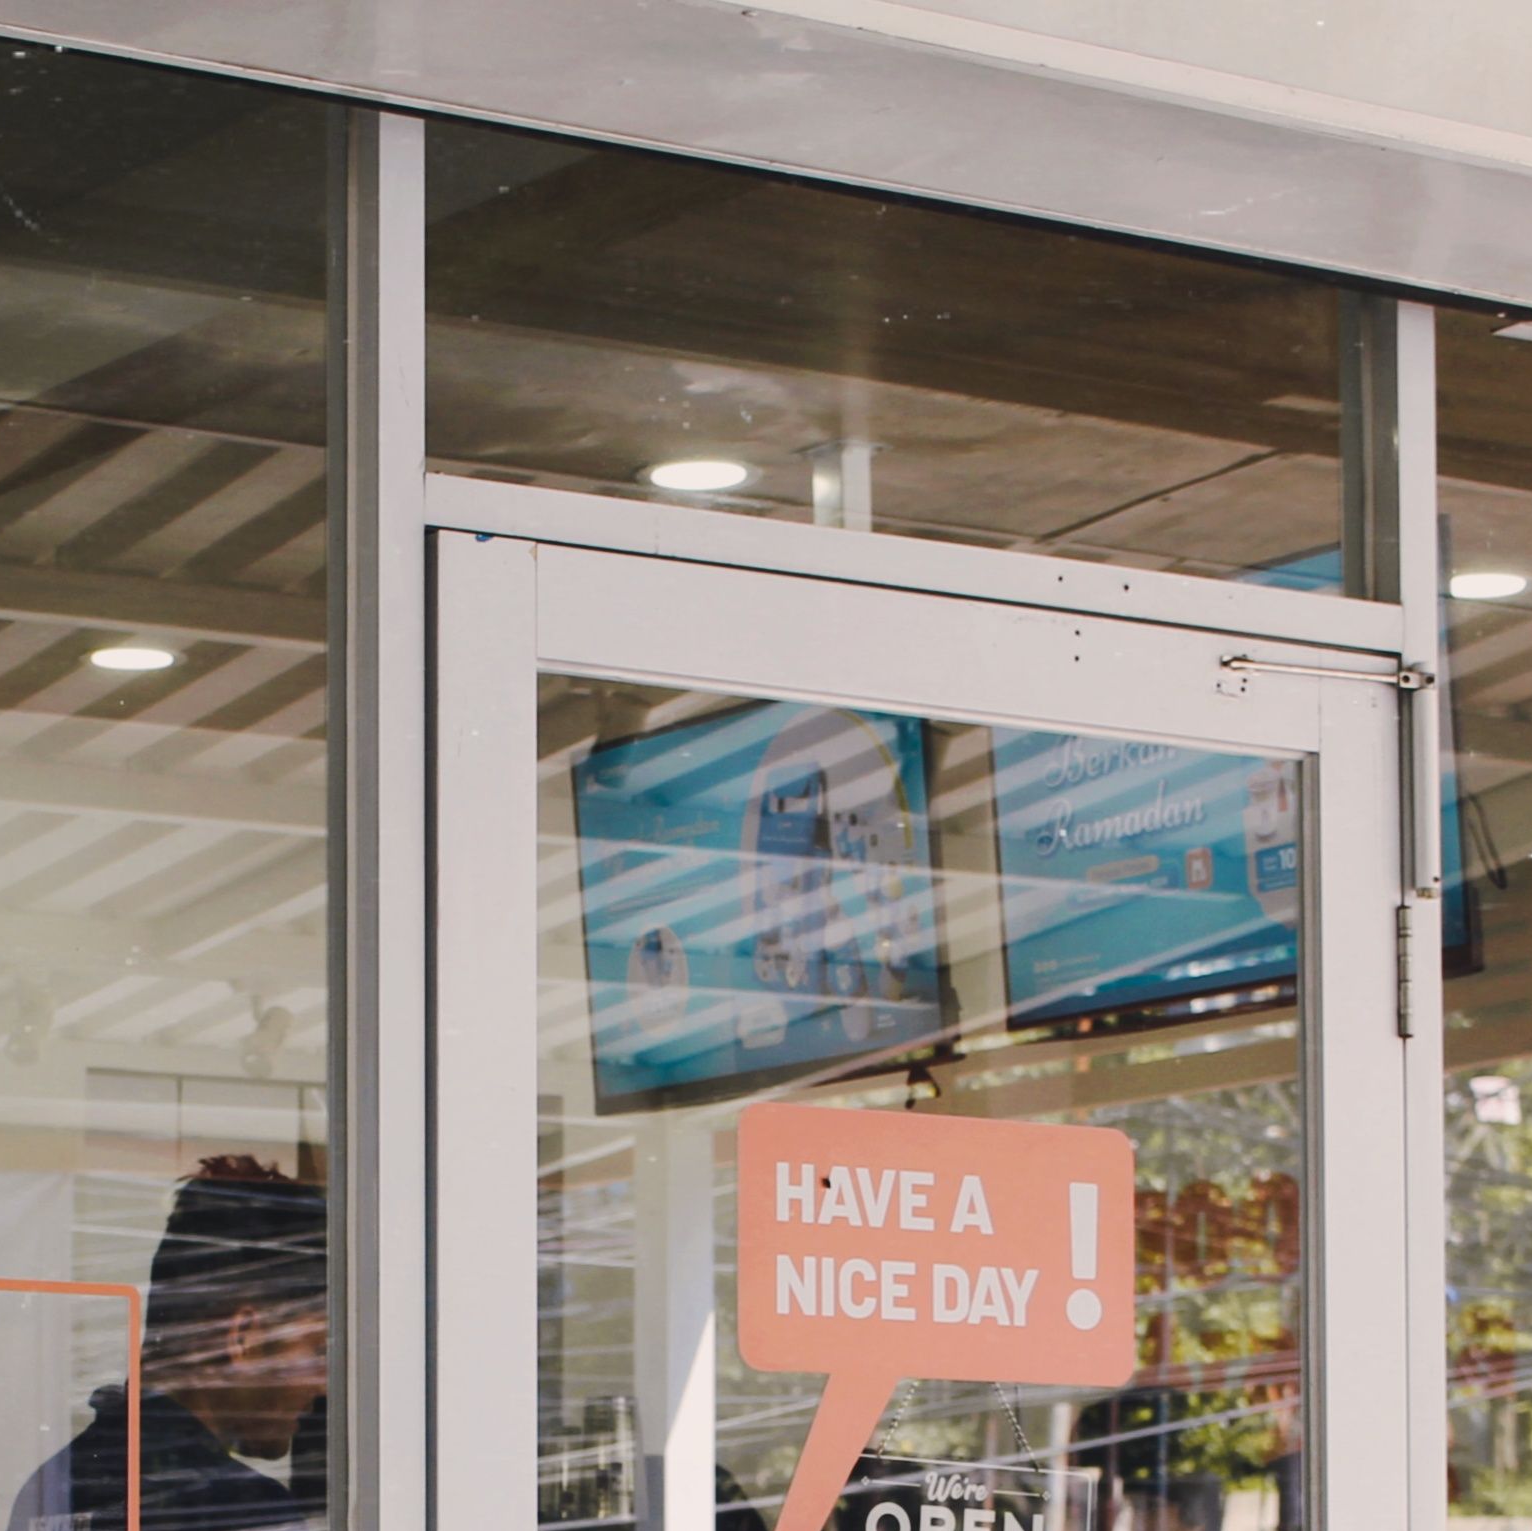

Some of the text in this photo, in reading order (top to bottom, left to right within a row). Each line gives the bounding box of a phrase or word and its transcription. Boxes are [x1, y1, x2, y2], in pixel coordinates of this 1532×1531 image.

[1038, 781, 1203, 855] Ramadan
[776, 1161, 993, 1235] HAVE A
[776, 1255, 1039, 1328] NICE DAY
[925, 1471, 989, 1502] We're
